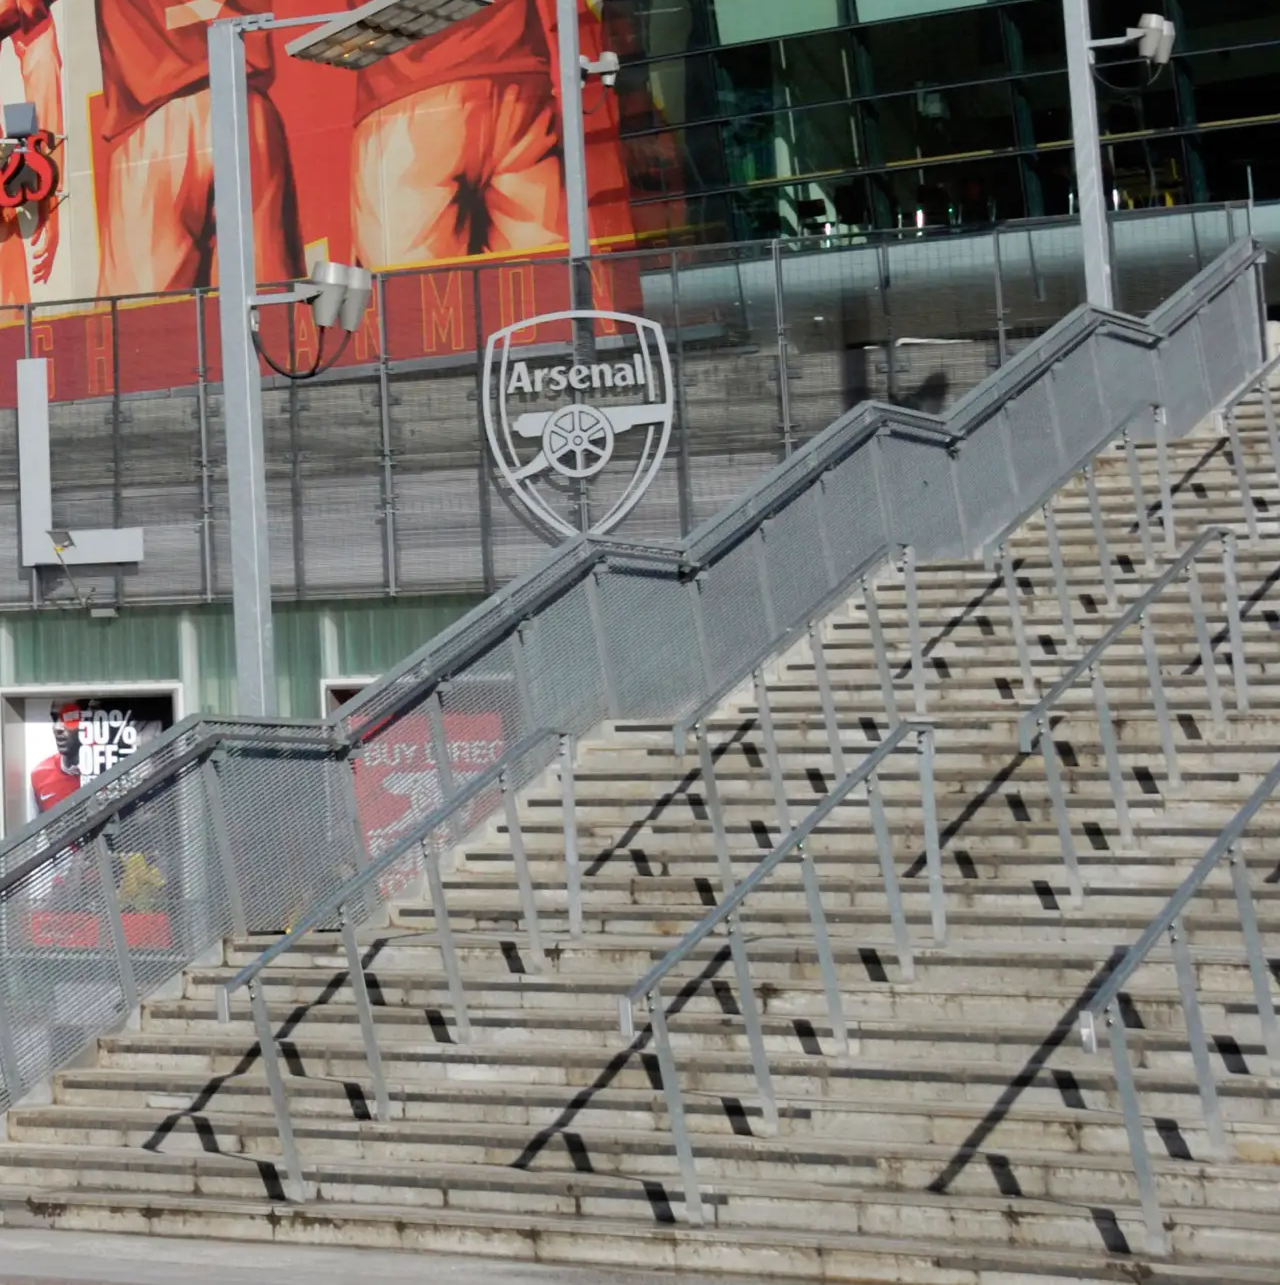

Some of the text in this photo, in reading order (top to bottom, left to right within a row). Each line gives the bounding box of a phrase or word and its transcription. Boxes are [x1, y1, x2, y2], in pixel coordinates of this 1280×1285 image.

[506, 353, 647, 396] Arsenal
[78, 709, 138, 745] 50%
[78, 744, 119, 775] OFF
[363, 742, 418, 766] BUY
